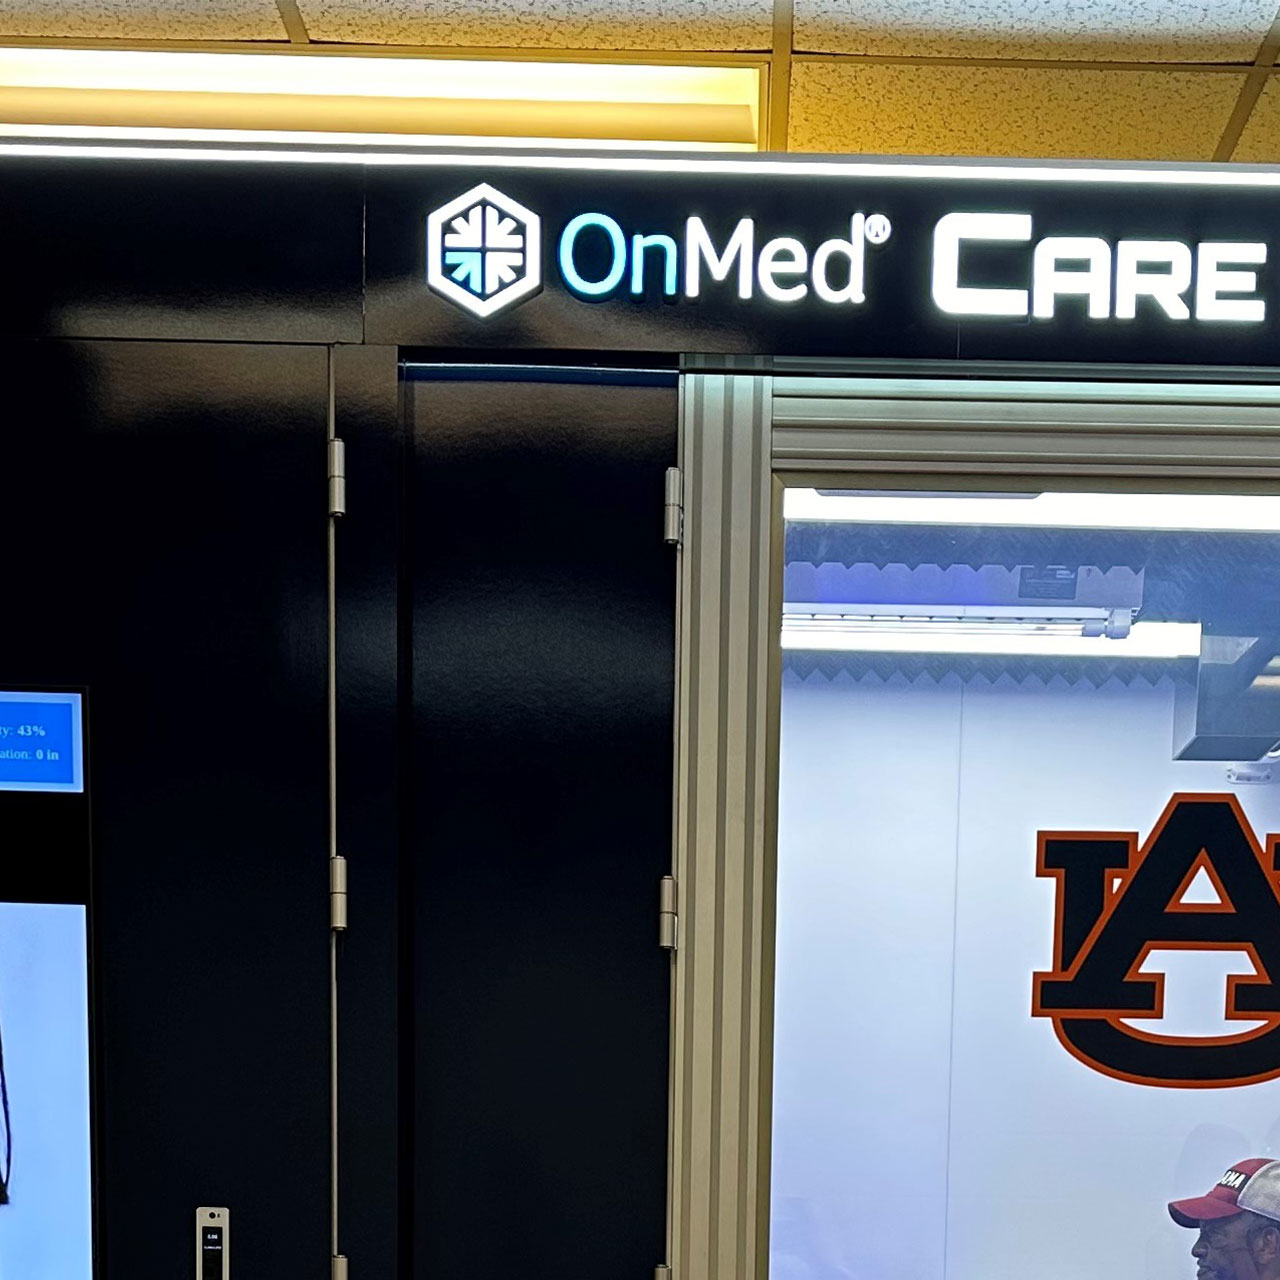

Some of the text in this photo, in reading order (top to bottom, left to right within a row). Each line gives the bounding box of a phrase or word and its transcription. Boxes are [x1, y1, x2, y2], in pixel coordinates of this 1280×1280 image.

[931, 211, 1268, 323] CARE
[16, 724, 46, 737] 43%
[46, 748, 60, 761] in
